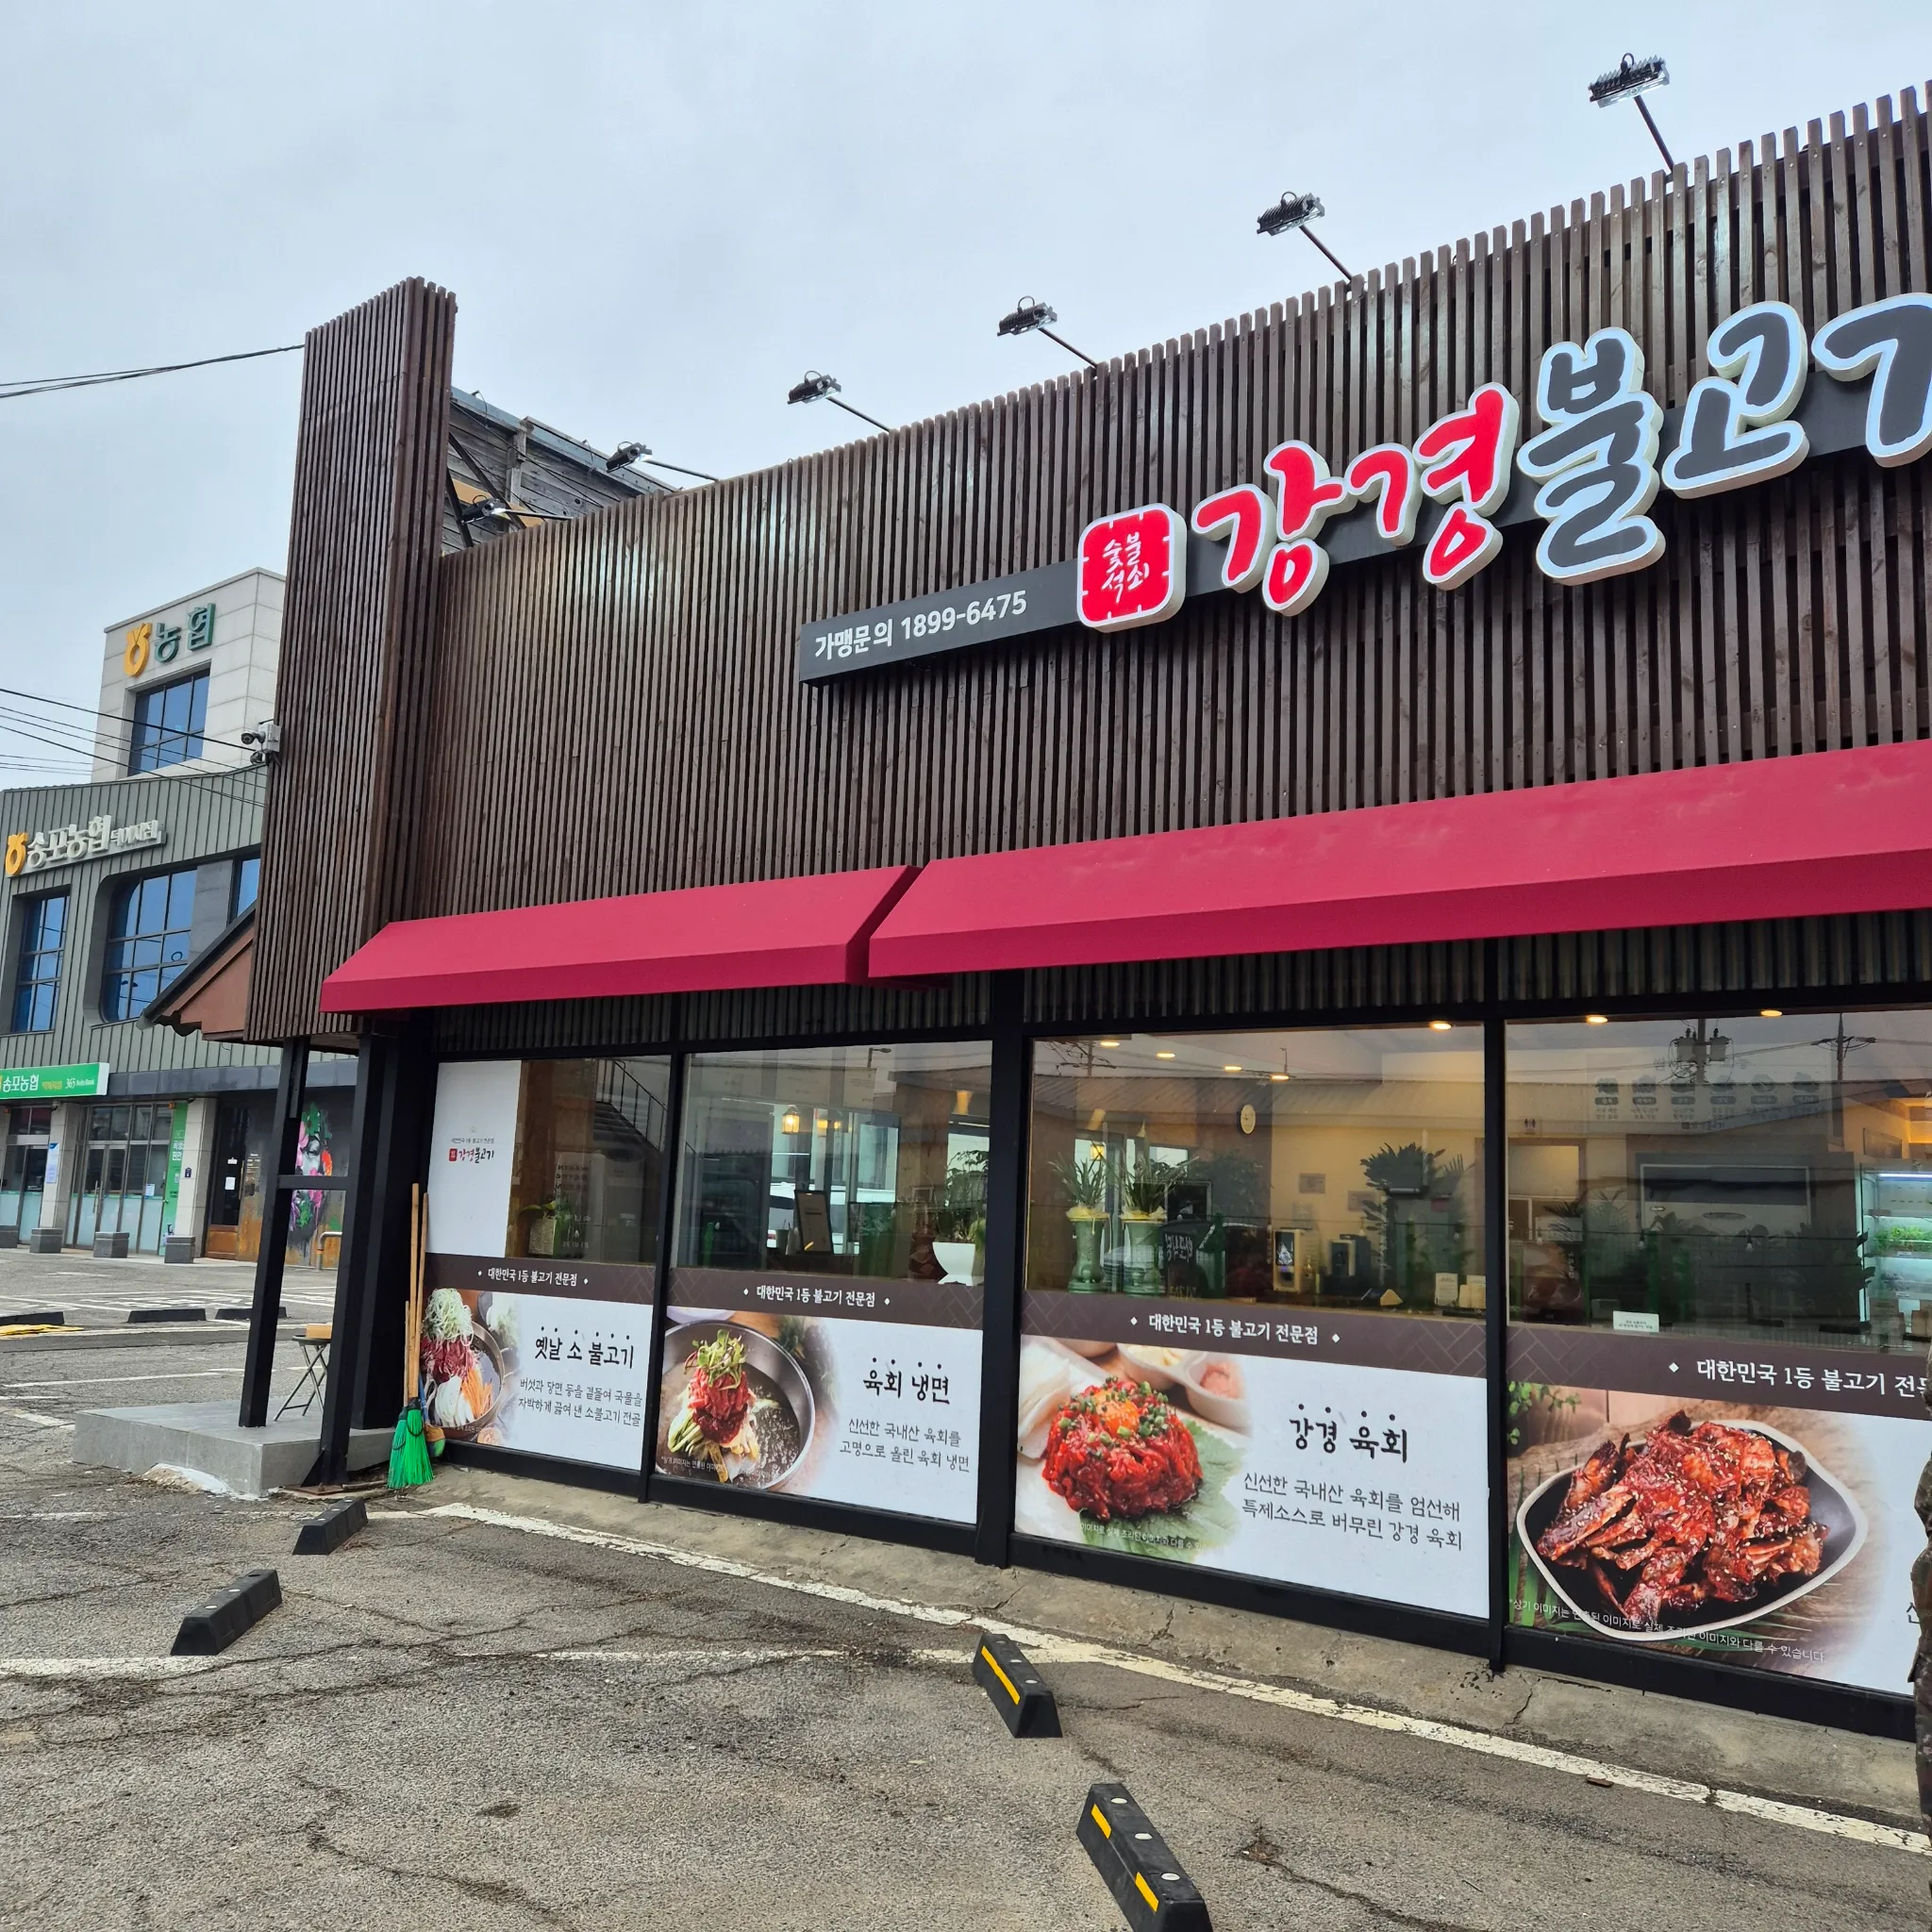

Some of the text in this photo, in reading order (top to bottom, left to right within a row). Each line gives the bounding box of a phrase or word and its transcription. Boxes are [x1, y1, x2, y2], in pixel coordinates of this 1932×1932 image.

[1102, 531, 1141, 573] 숯불
[1101, 562, 1150, 604] 석쇠
[154, 603, 216, 663] 농협
[815, 590, 1027, 660] 가맹문의 1899-6475
[27, 814, 112, 869] 송포농협
[2, 1074, 39, 1092] 송포농협
[488, 1268, 577, 1287] 대한민국 1등 불고기 전문점
[757, 1285, 875, 1307] 대한민국 1등 불고기 전문점
[1148, 1313, 1318, 1345] 대한민국 1등 불고기 전문점
[535, 1337, 633, 1369] 옛날 소 불고기
[520, 1377, 543, 1392] 버섯과
[547, 1381, 562, 1396] 당면
[565, 1383, 583, 1399] 등을
[614, 1391, 642, 1407] 국물을
[863, 1370, 950, 1405] 육회 냉면
[1697, 1358, 1777, 1386] 대한민국
[1784, 1366, 1814, 1390] 1등
[1822, 1369, 1886, 1394] 불고기
[518, 1397, 641, 1427] 자박하게 끓여 낸 소불고기 전골
[849, 1418, 961, 1448] 신선한 국내산 육회를
[1290, 1418, 1407, 1463] 강경 육회
[840, 1441, 969, 1473] 고명으로 올린 육회 냉면
[1244, 1472, 1460, 1522] 신선한 국내산 육회를 엄선해
[1242, 1498, 1462, 1551] 특제소스로 버무린 강경 육회
[1534, 1603, 1571, 1619] 이미지는
[1603, 1614, 1642, 1629] 이미지로
[1644, 1621, 1663, 1634] 실제
[1699, 1631, 1740, 1648] 이미지와
[1743, 1639, 1763, 1653] 다를
[1766, 1643, 1778, 1655] 수
